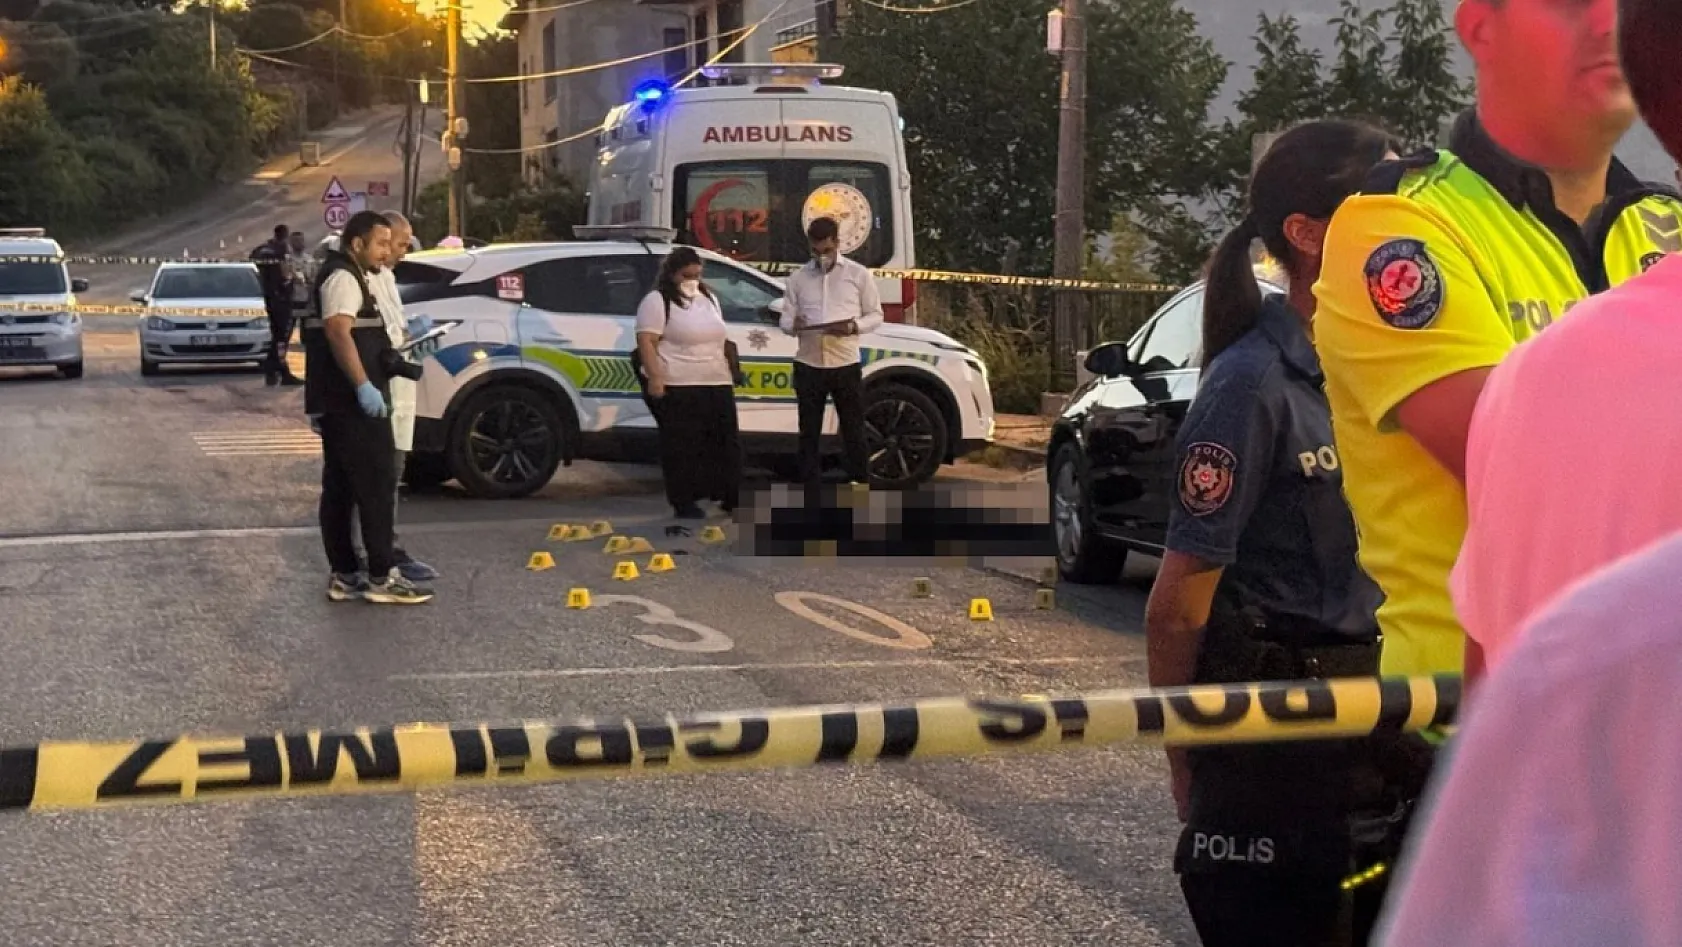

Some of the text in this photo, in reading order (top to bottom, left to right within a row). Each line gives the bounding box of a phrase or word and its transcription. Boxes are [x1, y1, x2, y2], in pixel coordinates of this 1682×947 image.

[703, 126, 852, 143] AMBULANS
[711, 210, 769, 233] 112
[500, 276, 520, 288] 112
[1298, 445, 1338, 476] PO
